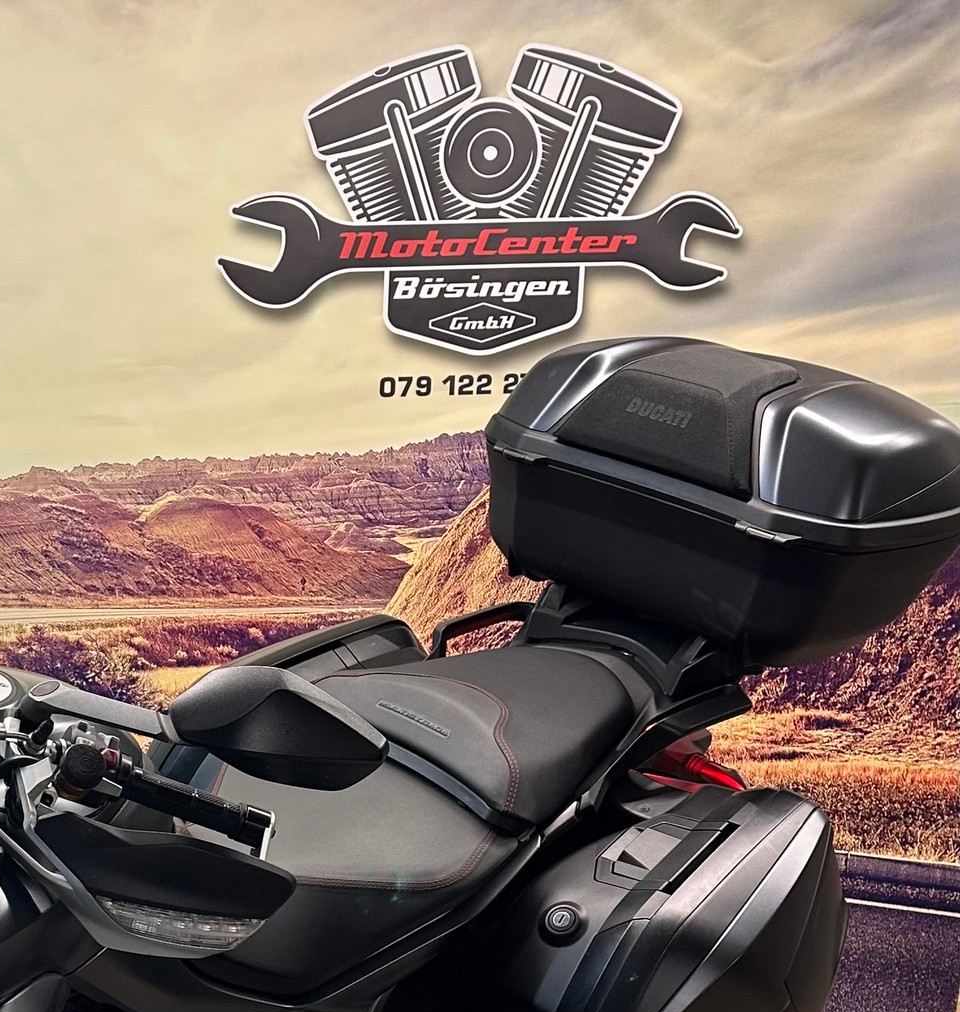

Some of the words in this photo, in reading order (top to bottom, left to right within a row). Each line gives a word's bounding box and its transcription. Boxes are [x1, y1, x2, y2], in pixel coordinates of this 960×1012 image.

[339, 227, 637, 260] MotoCenter
[392, 275, 572, 302] Bösingen
[449, 315, 516, 330] GmbH
[379, 375, 432, 398] 079
[442, 374, 492, 396] 122
[625, 397, 692, 428] DUCATI
